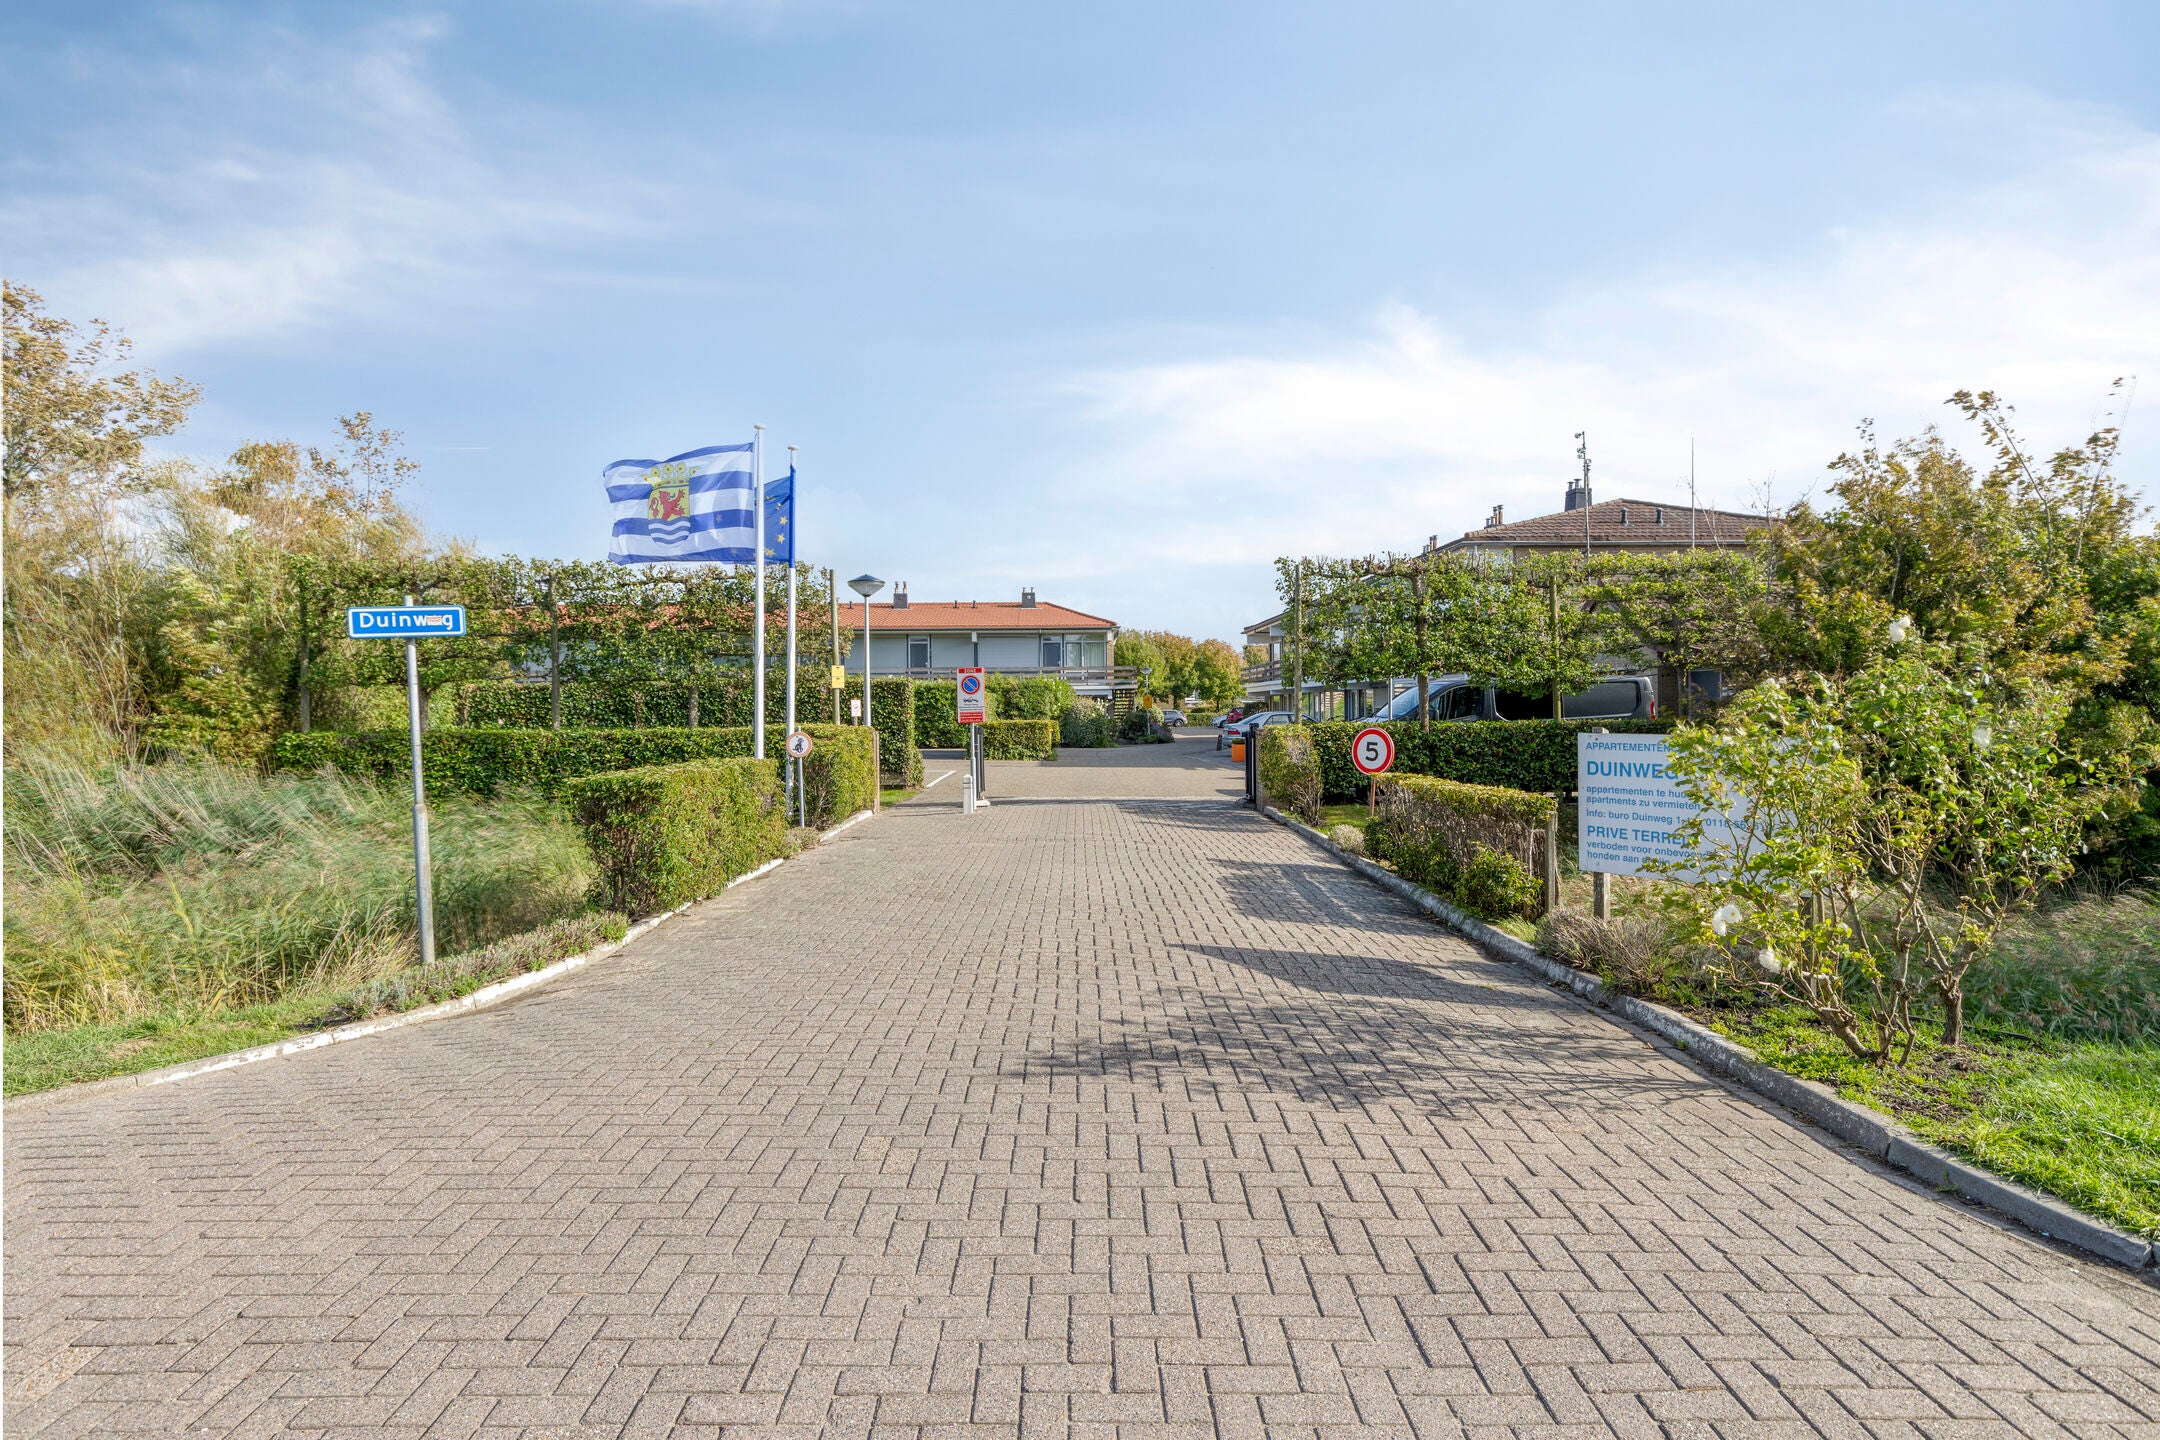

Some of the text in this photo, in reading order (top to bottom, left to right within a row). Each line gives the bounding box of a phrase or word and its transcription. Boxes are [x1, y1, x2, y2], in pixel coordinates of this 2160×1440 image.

[359, 612, 453, 630] Duinwg
[1365, 741, 1379, 762] 5
[1587, 760, 1679, 780] DUINWEG
[1586, 785, 1688, 799] appartementen te huu
[1586, 795, 1701, 810] apartments zu vermieten
[1586, 809, 1606, 818] Info:
[1608, 810, 1630, 820] buro
[1632, 812, 1673, 825] Duinweg
[1587, 825, 1686, 846] PRIVE TERREI
[1587, 841, 1629, 851] verboden
[1631, 846, 1651, 854] voor
[1587, 850, 1620, 861] honden
[1622, 855, 1639, 863] aan
